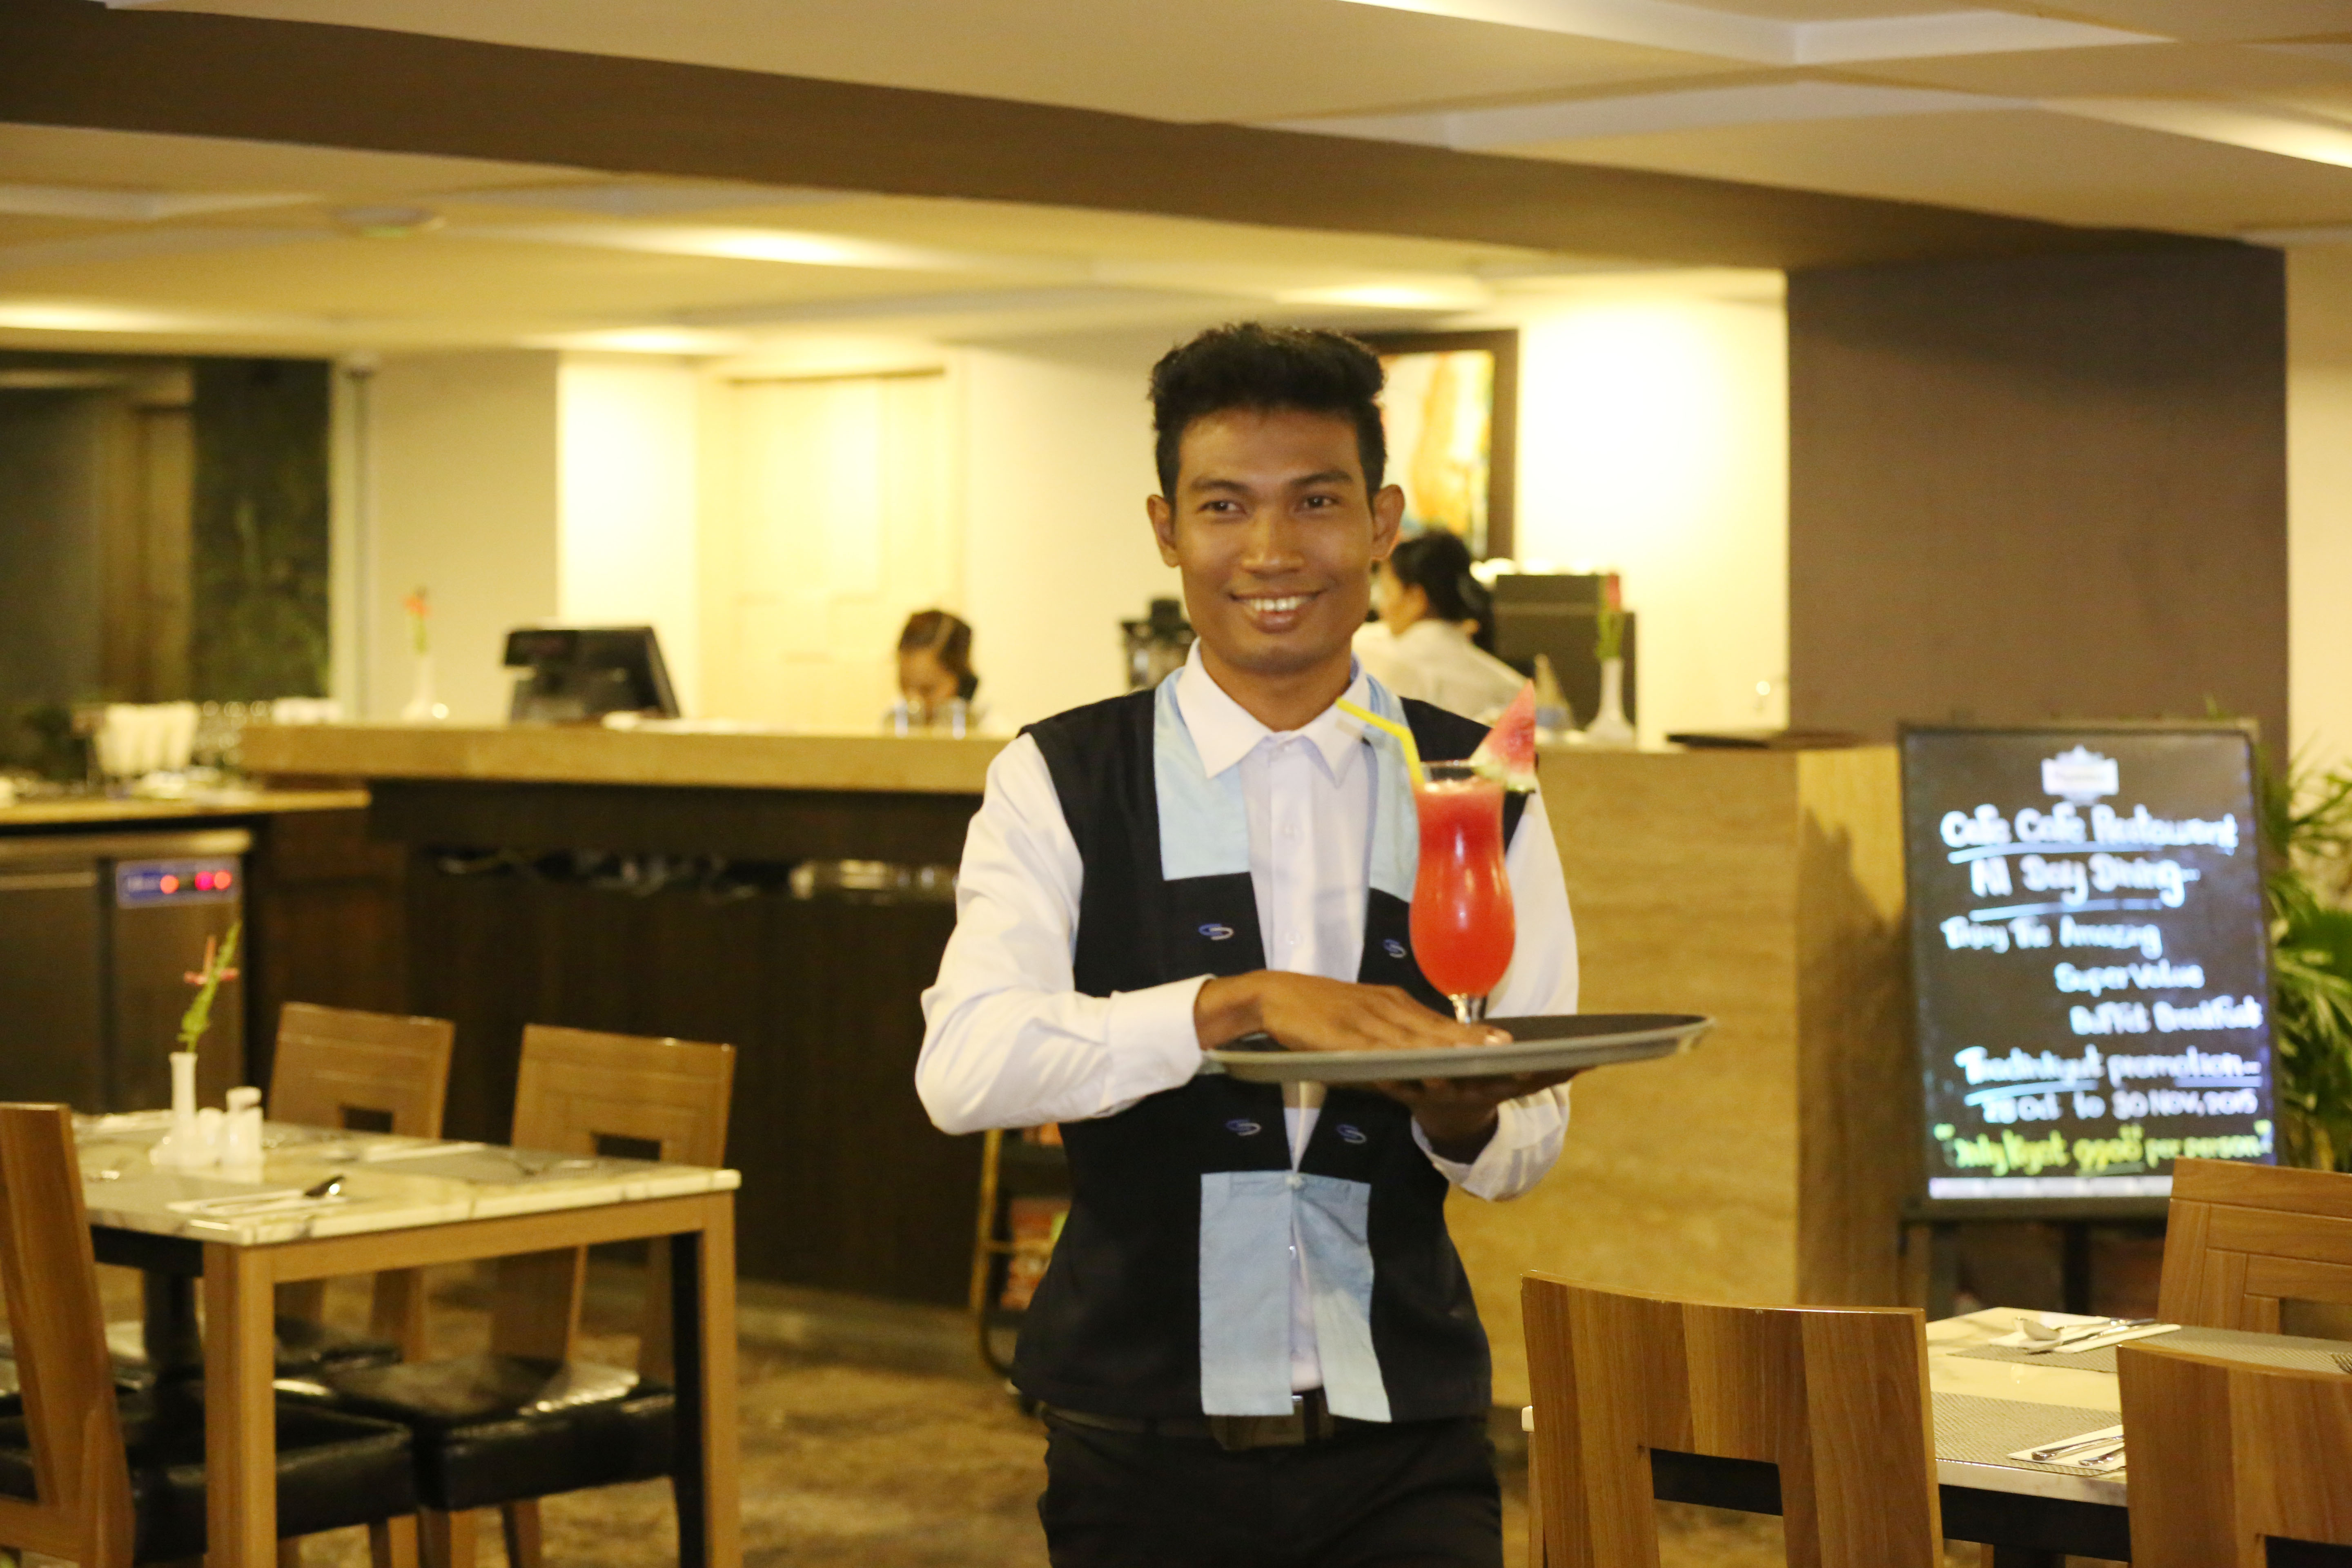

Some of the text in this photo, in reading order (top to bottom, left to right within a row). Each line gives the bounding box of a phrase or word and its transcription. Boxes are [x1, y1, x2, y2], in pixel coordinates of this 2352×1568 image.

[2020, 855, 2089, 906] Day
[2060, 914, 2163, 960] Amazing
[2055, 962, 2128, 997] Super
[2070, 995, 2264, 1036] Buffet Breakfast
